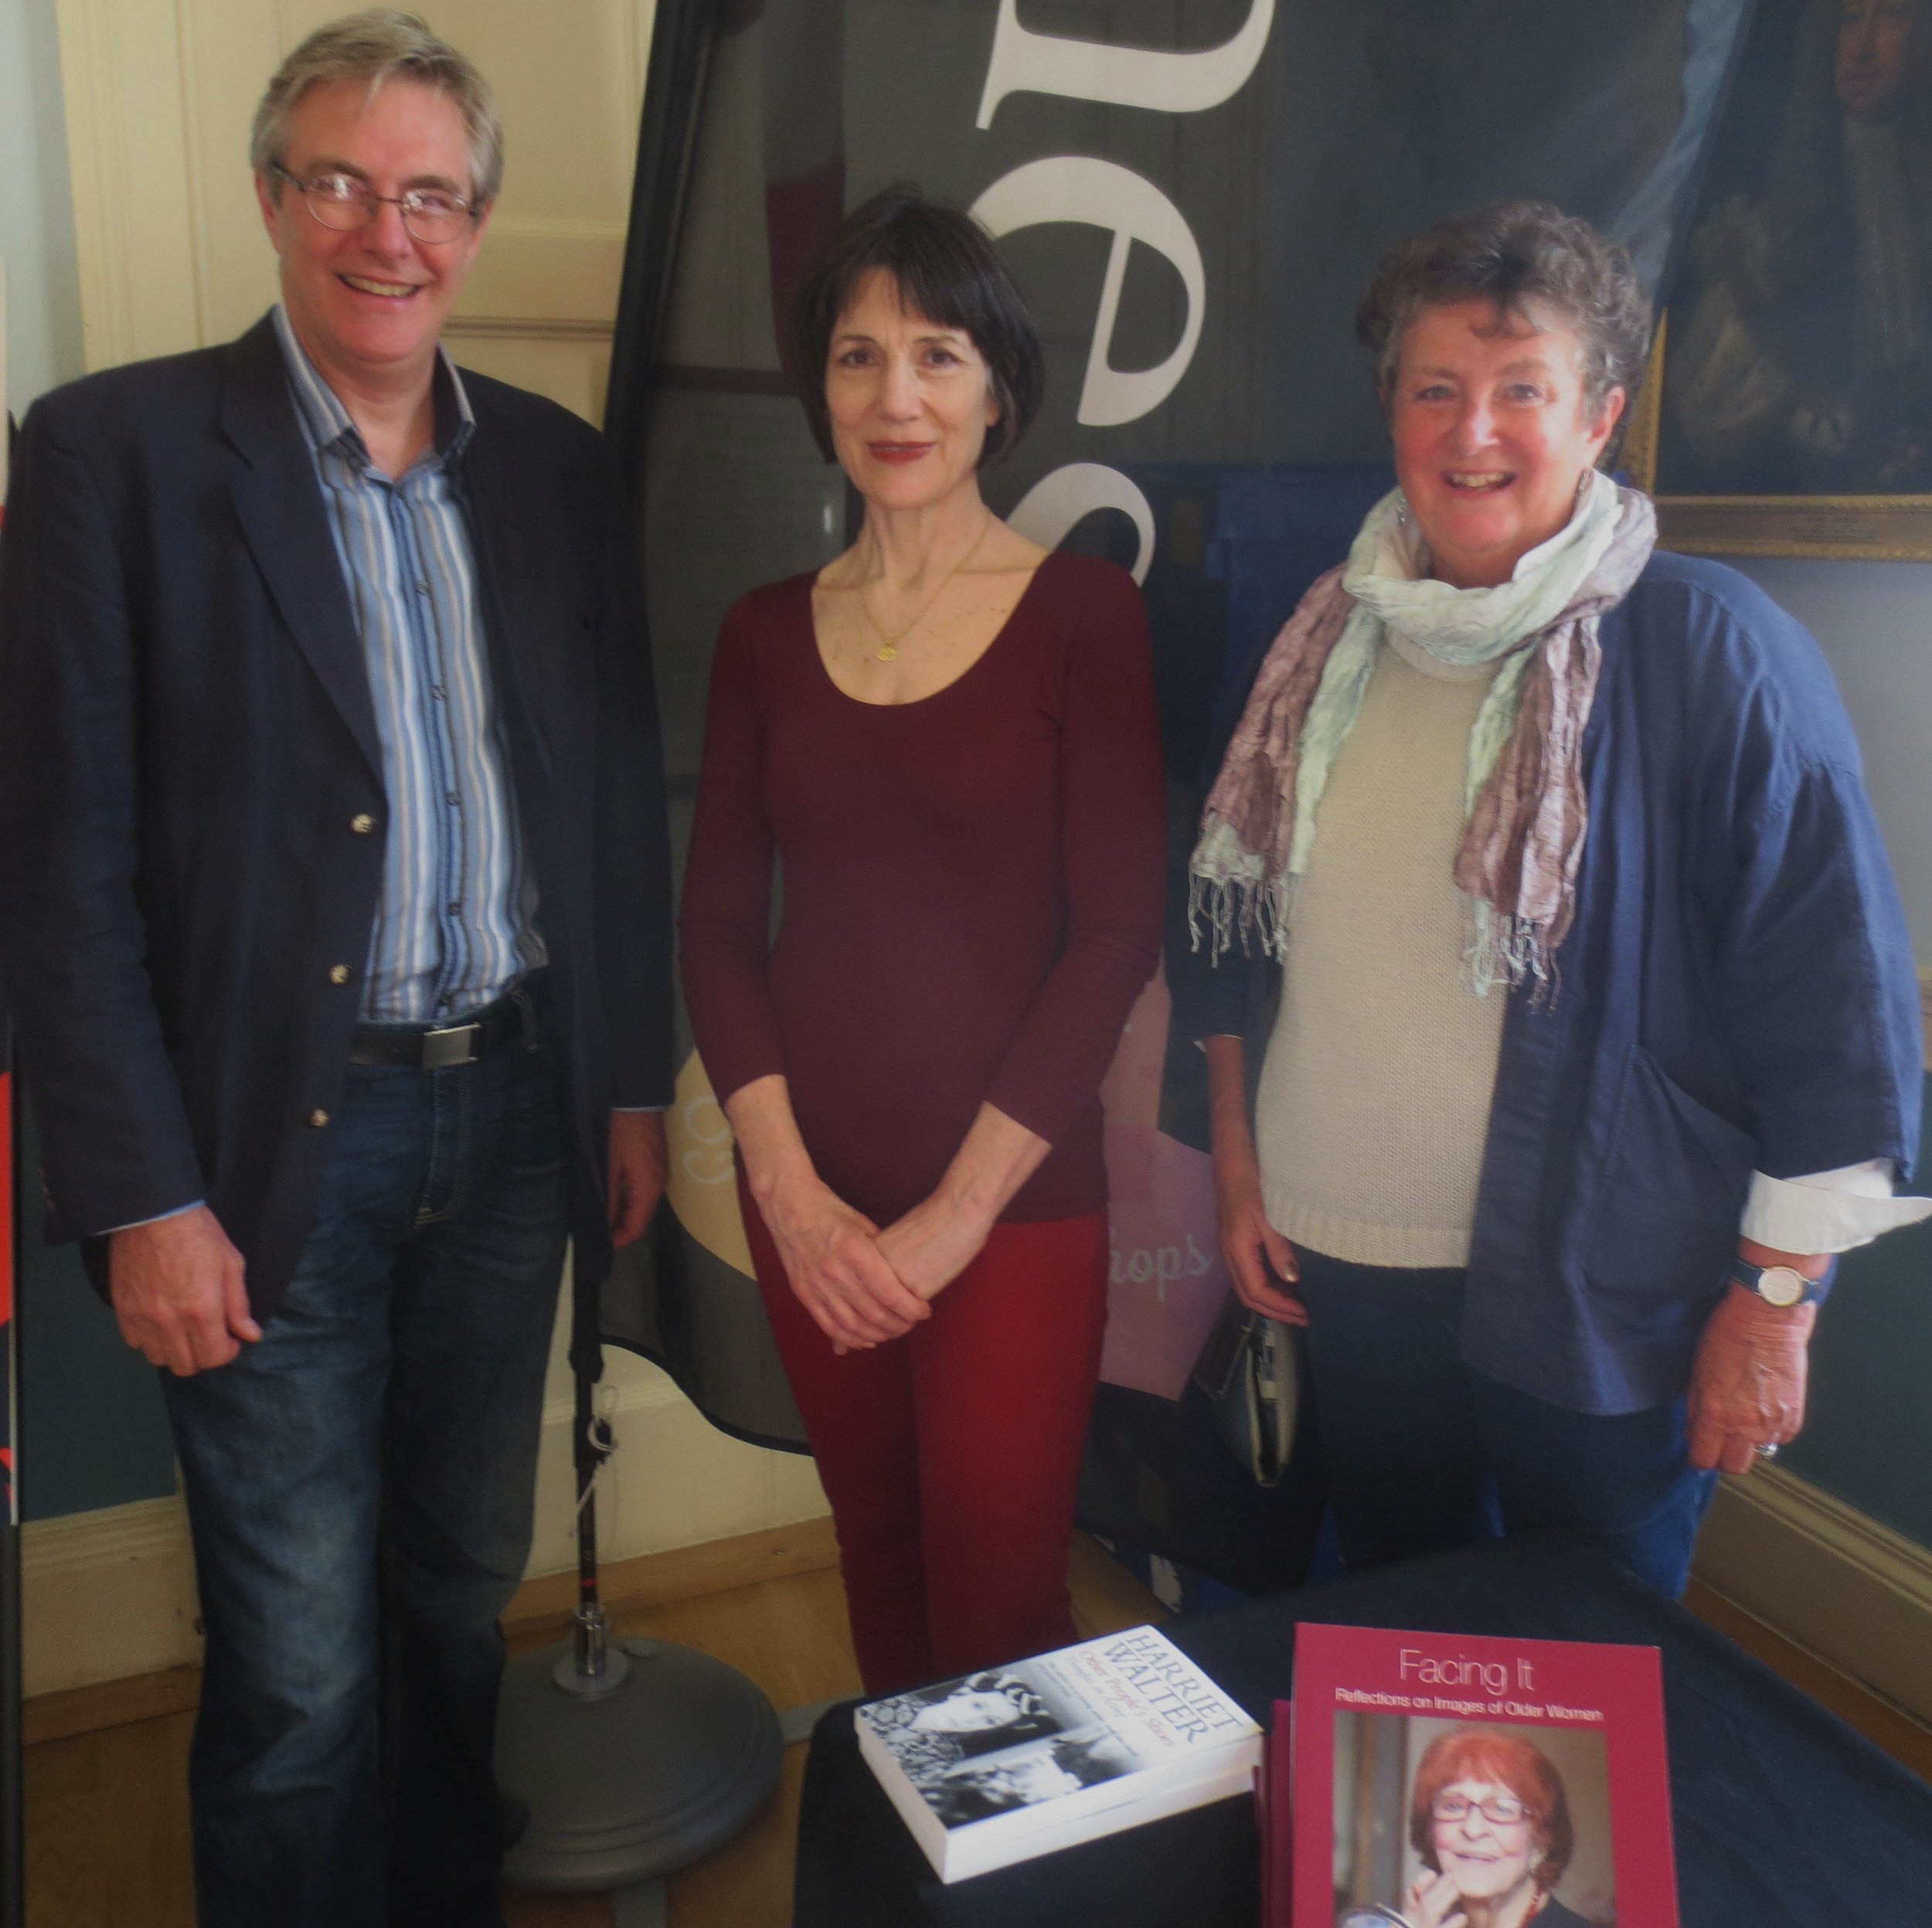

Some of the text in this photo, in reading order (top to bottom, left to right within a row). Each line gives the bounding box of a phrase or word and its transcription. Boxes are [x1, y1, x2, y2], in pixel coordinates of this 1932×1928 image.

[1078, 1650, 1176, 1747] Other People's Shoes
[1103, 1640, 1210, 1744] WALTER
[1126, 1634, 1243, 1730] HARRIET
[1335, 1687, 1604, 1722] Reflections on Images of Older Women
[1400, 1648, 1536, 1696] Facing It
